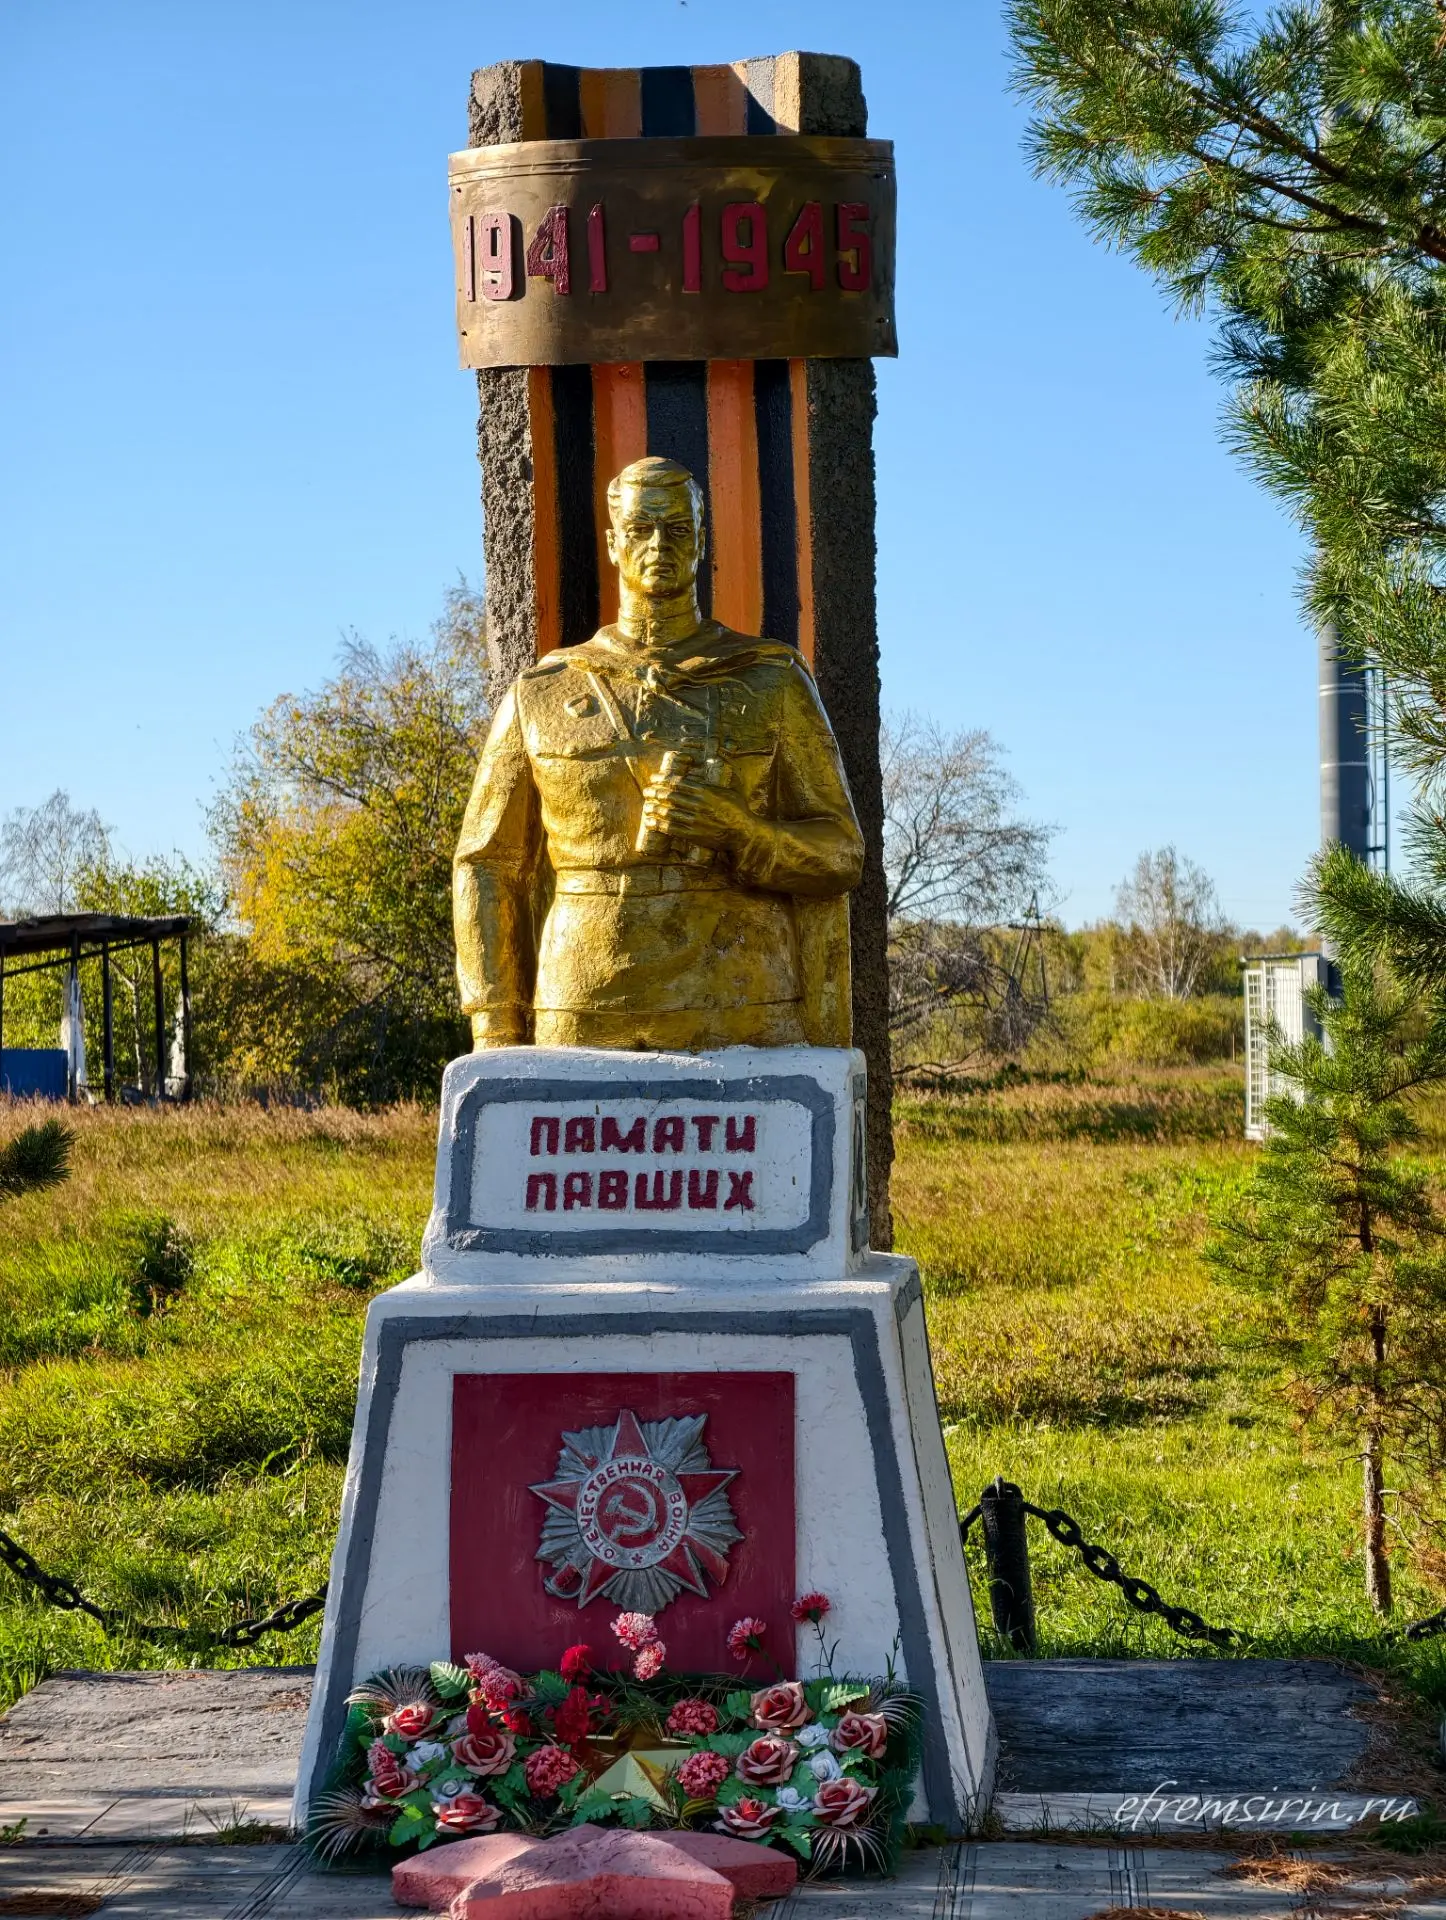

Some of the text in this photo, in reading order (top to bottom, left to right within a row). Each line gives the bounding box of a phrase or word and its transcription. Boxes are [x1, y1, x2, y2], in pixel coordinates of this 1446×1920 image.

[464, 202, 871, 302] 1941-1945
[525, 1170, 755, 1211] ПАВШИХ
[580, 1461, 665, 1559] ОТЕЧЕСТВЕННАЯ
